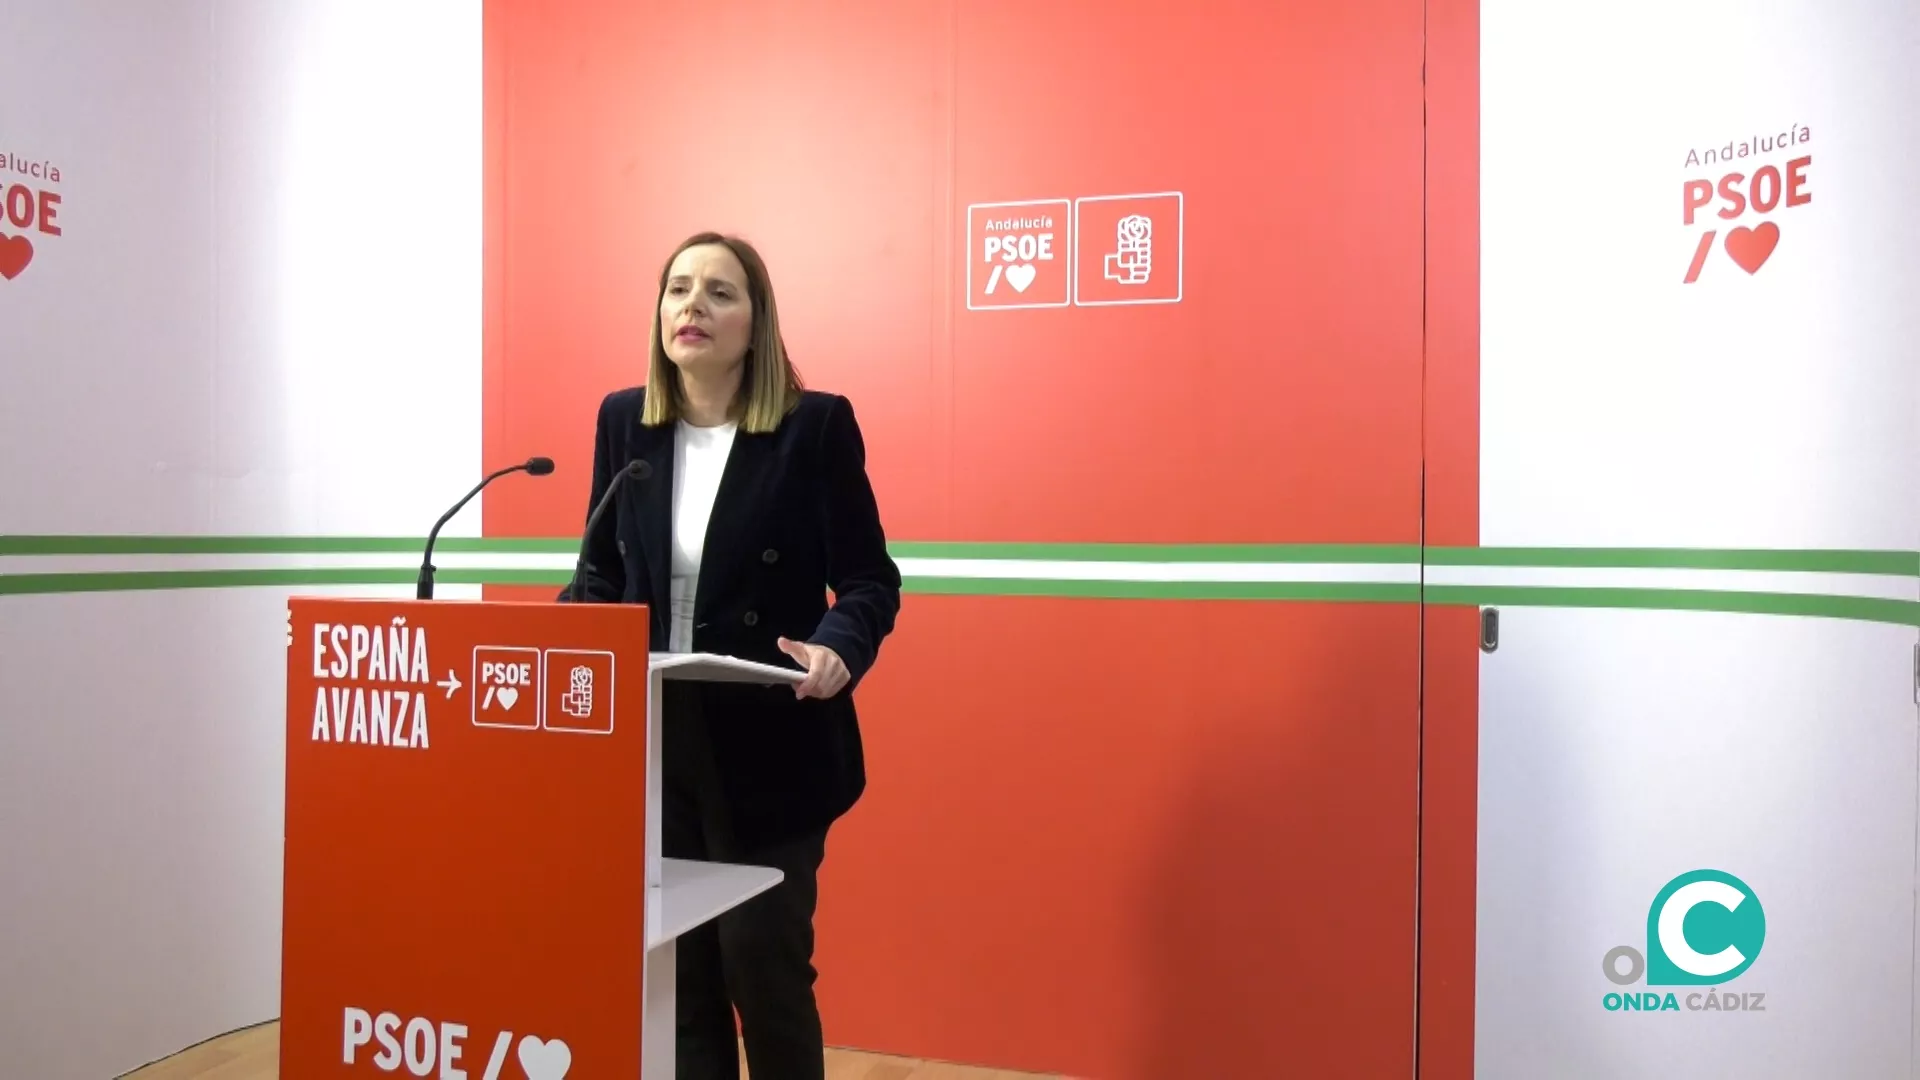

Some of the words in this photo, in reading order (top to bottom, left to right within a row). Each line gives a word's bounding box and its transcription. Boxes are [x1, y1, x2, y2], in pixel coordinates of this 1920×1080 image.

[1684, 123, 1811, 168] Andalucía
[0, 183, 62, 237] OE
[1683, 155, 1812, 226] PSOE
[984, 233, 1053, 262] PSOE
[985, 215, 1053, 231] Andalucía
[313, 616, 429, 683] ESPAÑA
[482, 662, 531, 685] PSOE
[312, 687, 429, 749] AVANZA
[343, 1007, 468, 1080] PSOE
